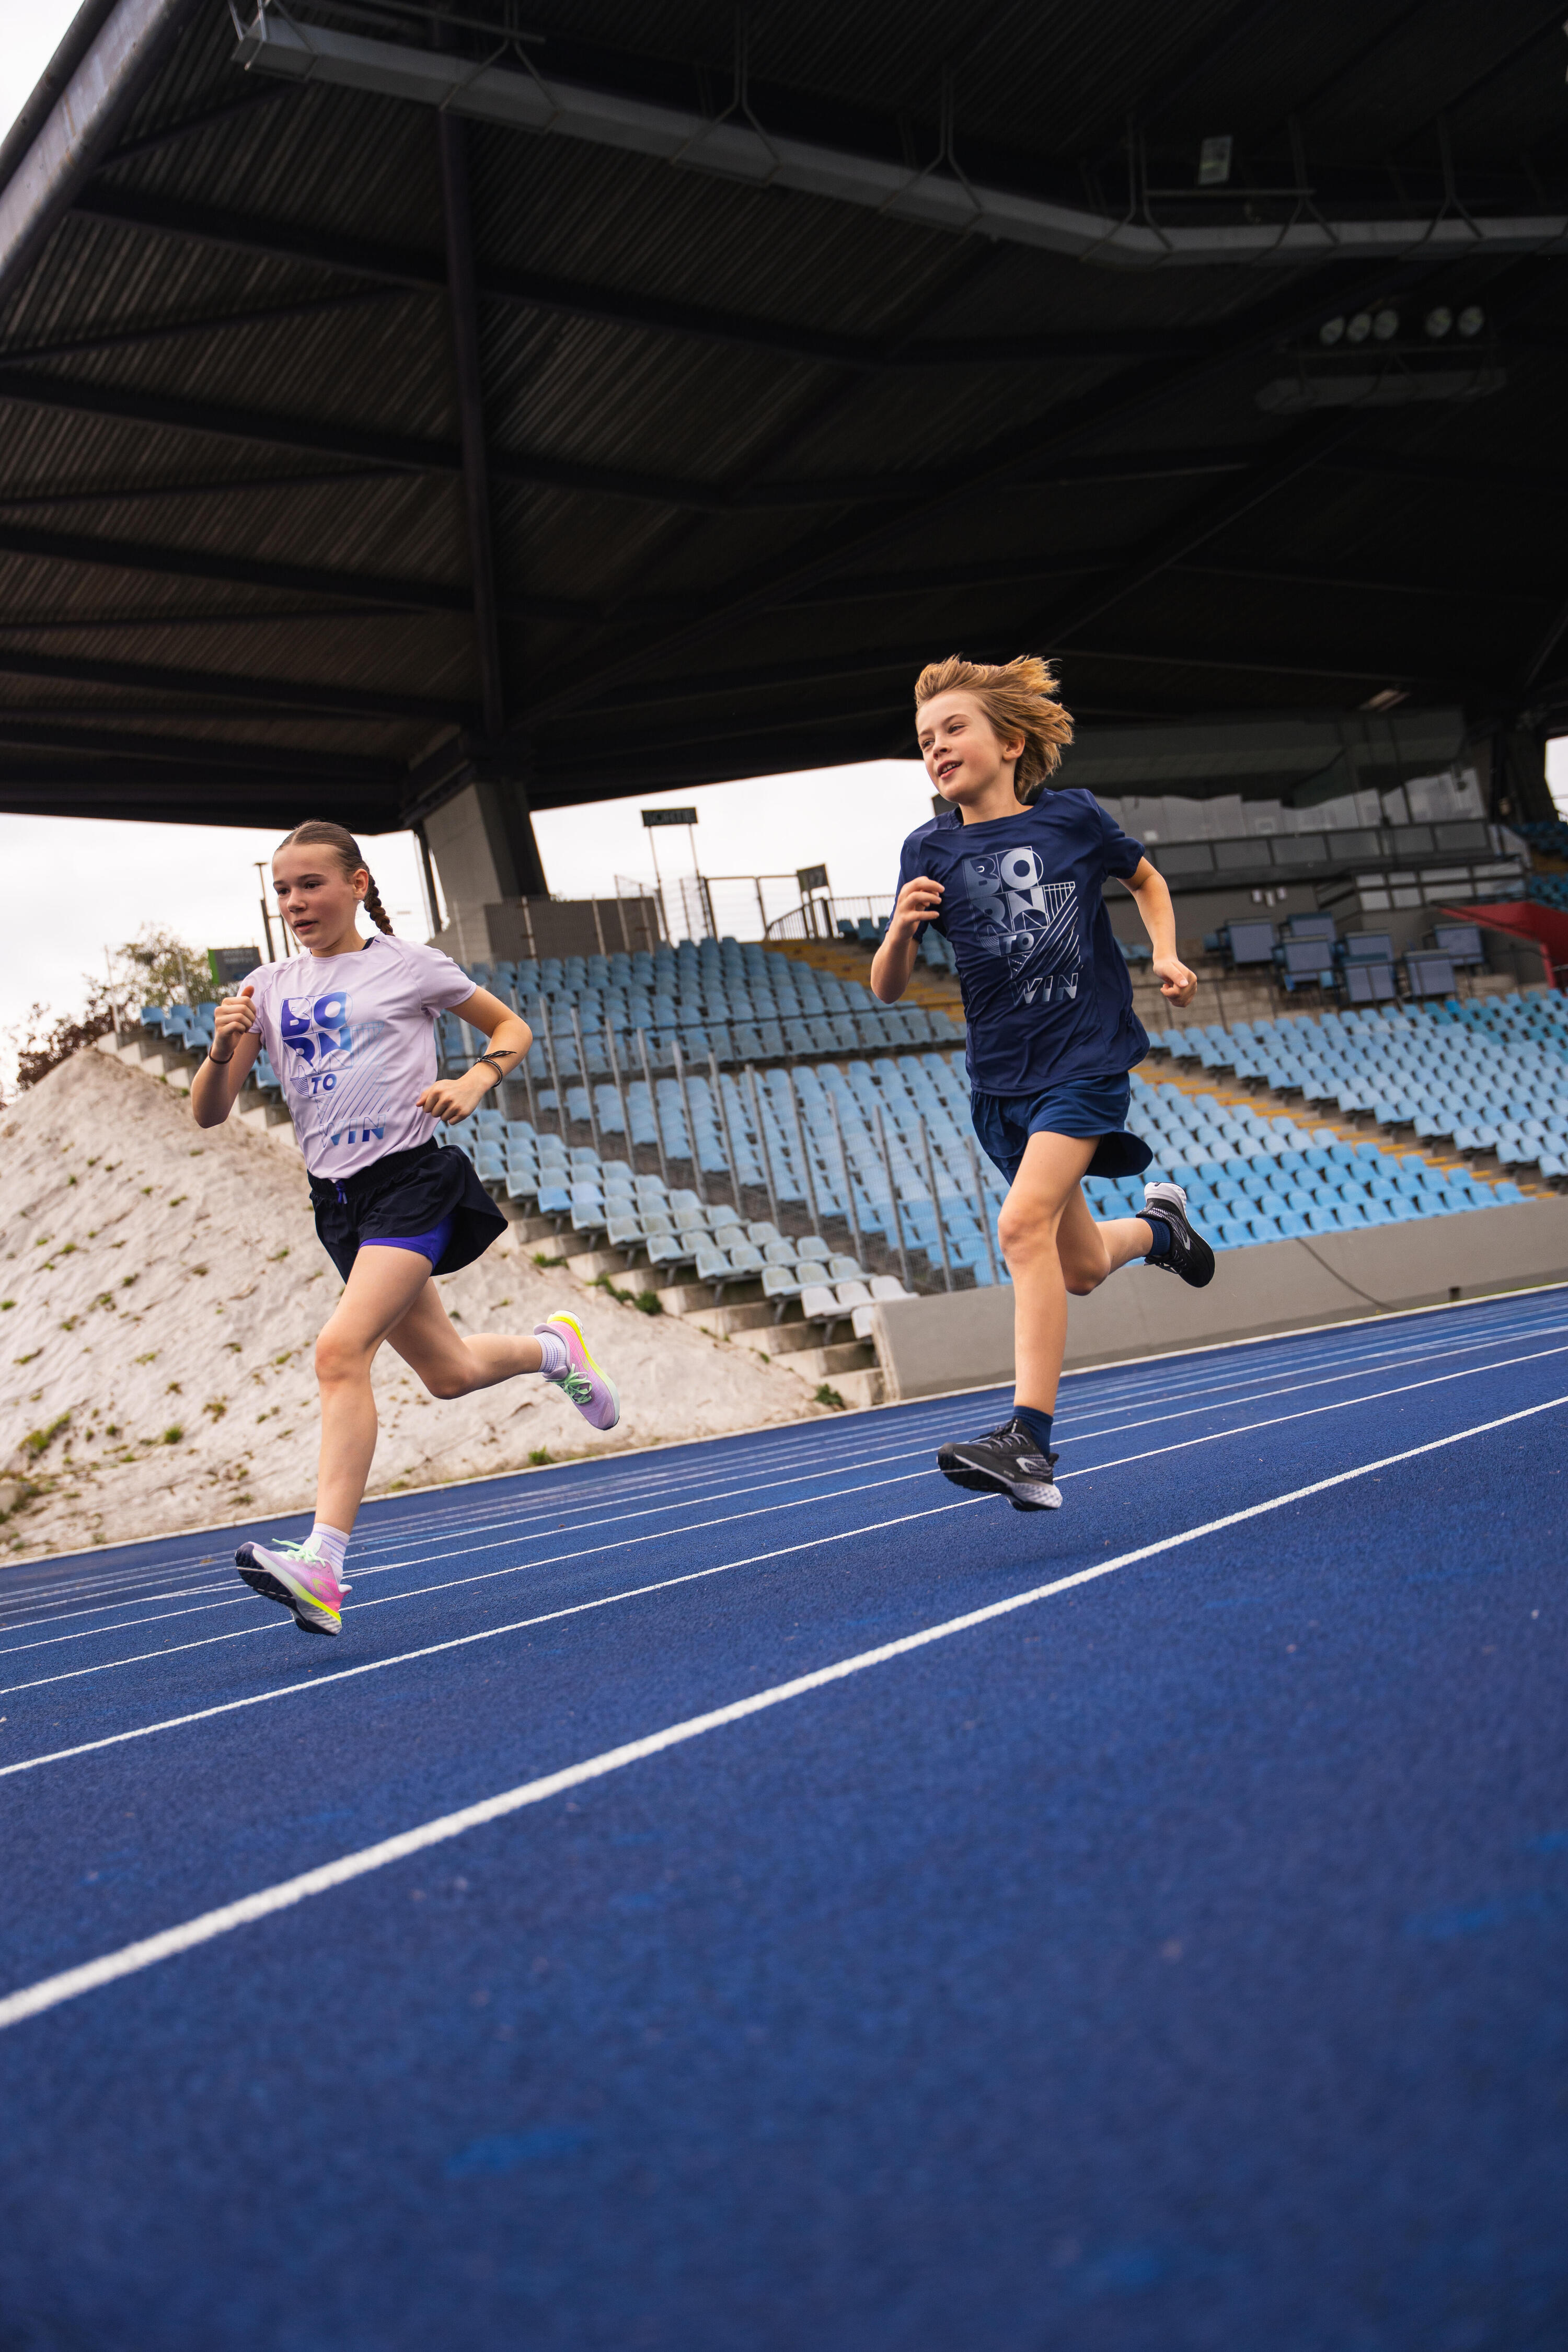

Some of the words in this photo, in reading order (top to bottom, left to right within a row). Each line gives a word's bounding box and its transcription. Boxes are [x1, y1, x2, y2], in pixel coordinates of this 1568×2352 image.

[1002, 932, 1034, 954] TO
[1009, 972, 1078, 1006] WIN
[312, 1073, 337, 1094] TO
[319, 1114, 386, 1148] WIN
